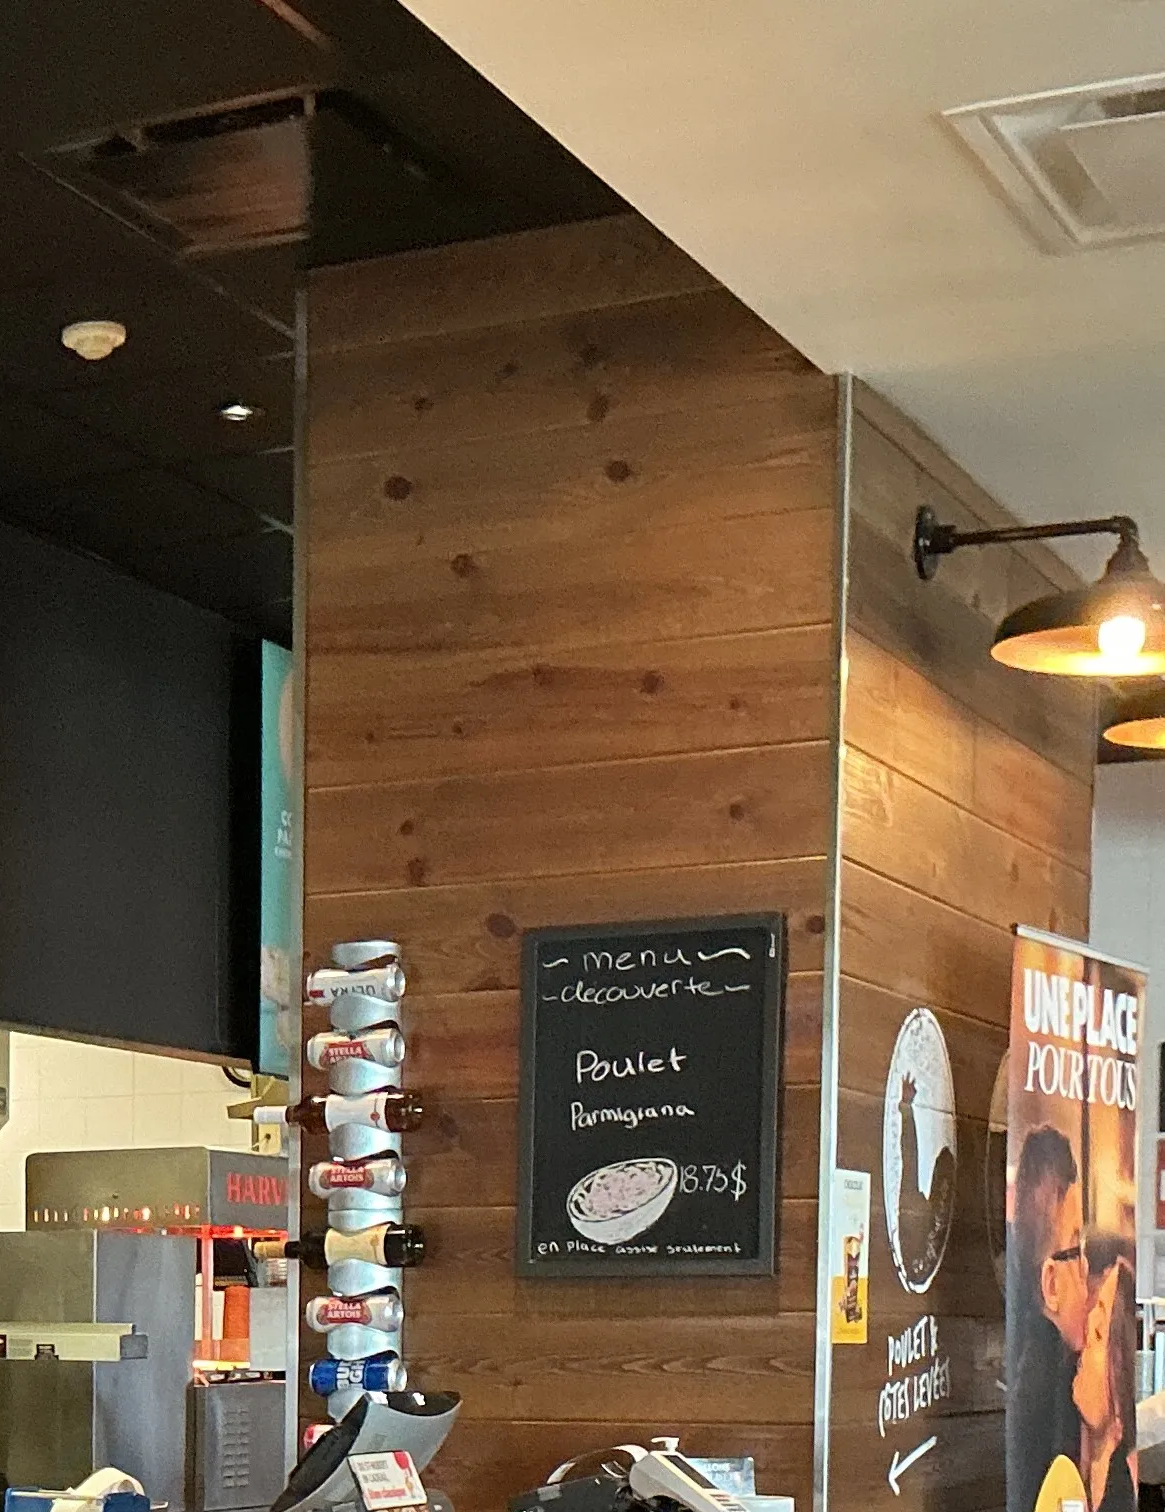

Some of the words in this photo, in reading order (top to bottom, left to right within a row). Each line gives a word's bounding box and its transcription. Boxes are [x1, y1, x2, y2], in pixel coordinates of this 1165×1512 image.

[583, 949, 692, 971] menu
[1023, 968, 1071, 1040] UNE
[1073, 981, 1138, 1056] PLACE
[328, 1046, 362, 1057] STELLA
[576, 1047, 687, 1084] Poulet
[1024, 1041, 1084, 1100] POUR
[1087, 1053, 1136, 1111] TOUS
[330, 1174, 365, 1183] ARTOIS
[327, 1309, 361, 1318] ARTOIS
[887, 1315, 928, 1377] POULET
